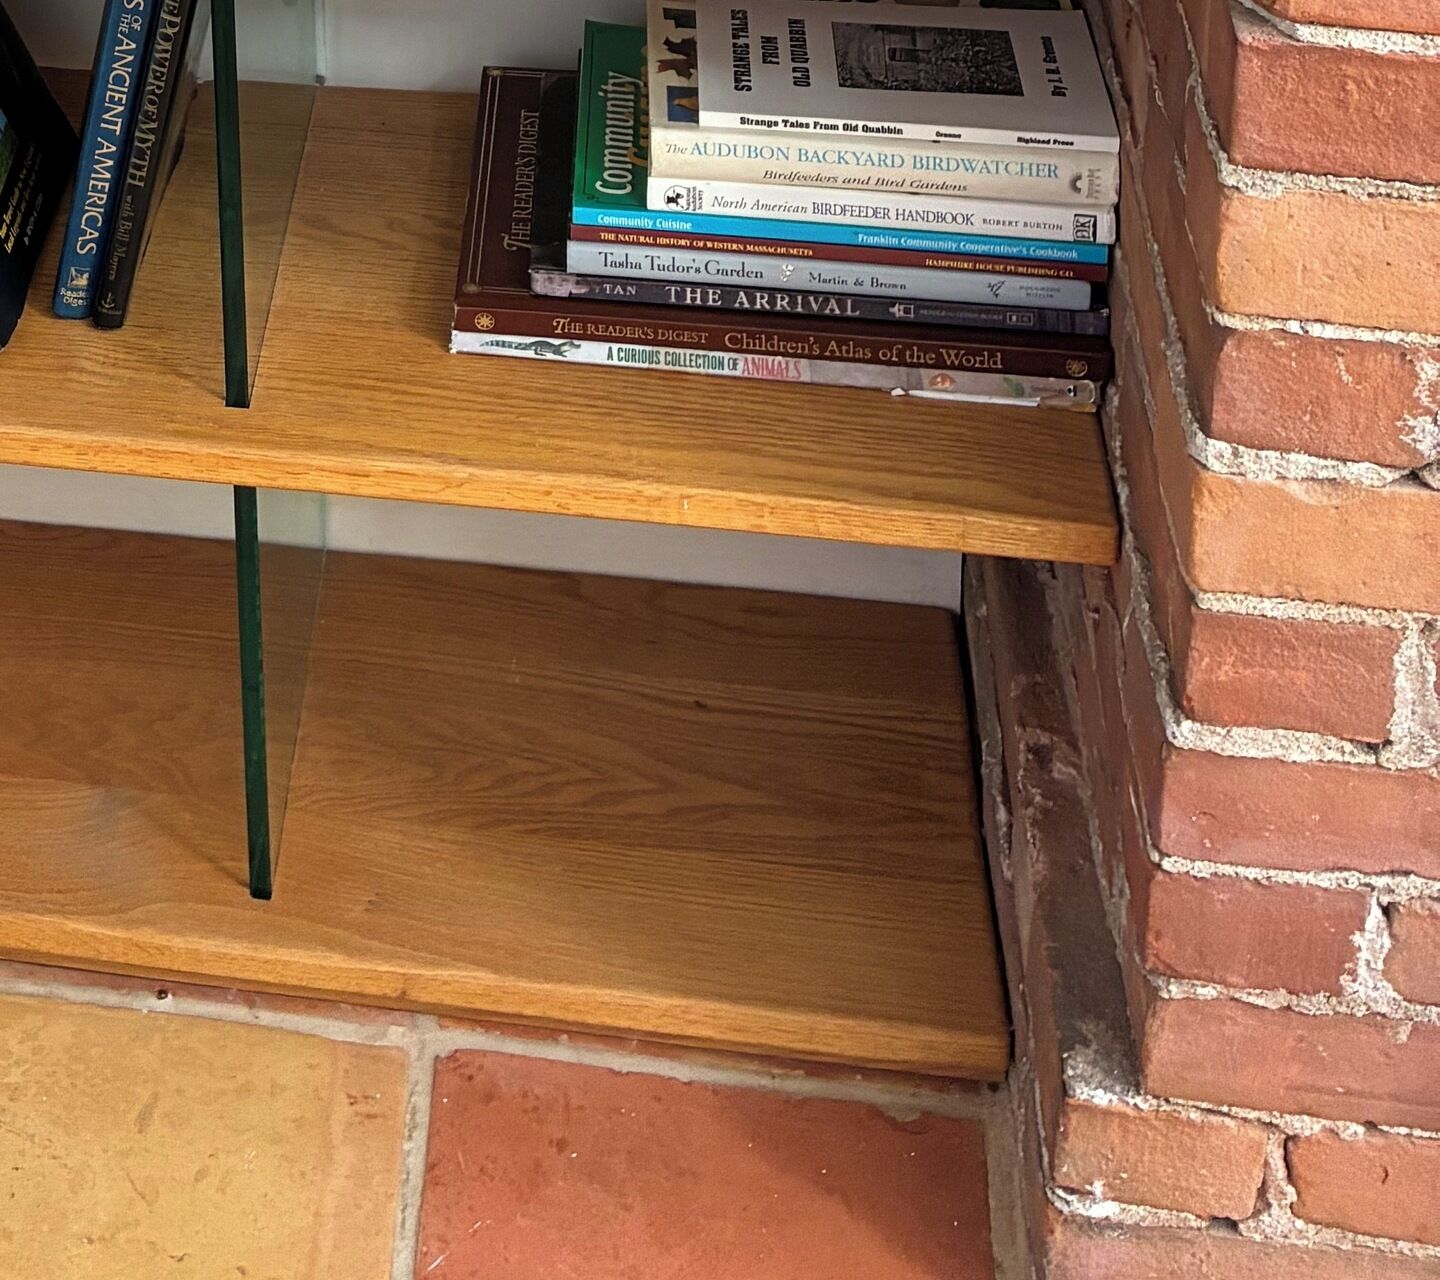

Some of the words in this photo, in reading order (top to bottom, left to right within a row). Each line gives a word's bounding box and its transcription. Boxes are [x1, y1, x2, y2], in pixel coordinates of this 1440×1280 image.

[117, 13, 132, 37] THE
[130, 15, 142, 31] OF
[103, 37, 137, 137] ANCIENT
[664, 143, 687, 155] The
[690, 142, 789, 162] AUDUBON
[798, 148, 904, 169] BACKYARD
[911, 155, 1060, 179] BIRDWATCHER
[77, 137, 117, 255] AMERICAS
[712, 195, 748, 210] North
[750, 198, 809, 215] American
[811, 202, 891, 221] BIRDFEEDER
[894, 207, 975, 226] HANDBOOK
[599, 251, 642, 270] Tasha
[644, 254, 702, 274] Tudor's
[705, 260, 764, 279] Garden
[603, 284, 637, 296] TAN
[665, 286, 722, 306] THE
[733, 290, 860, 316] ARRIVAL
[724, 332, 820, 356] Children's
[824, 340, 871, 359] Atlas
[878, 346, 900, 361] of
[905, 345, 936, 365] the
[939, 349, 1003, 370] World
